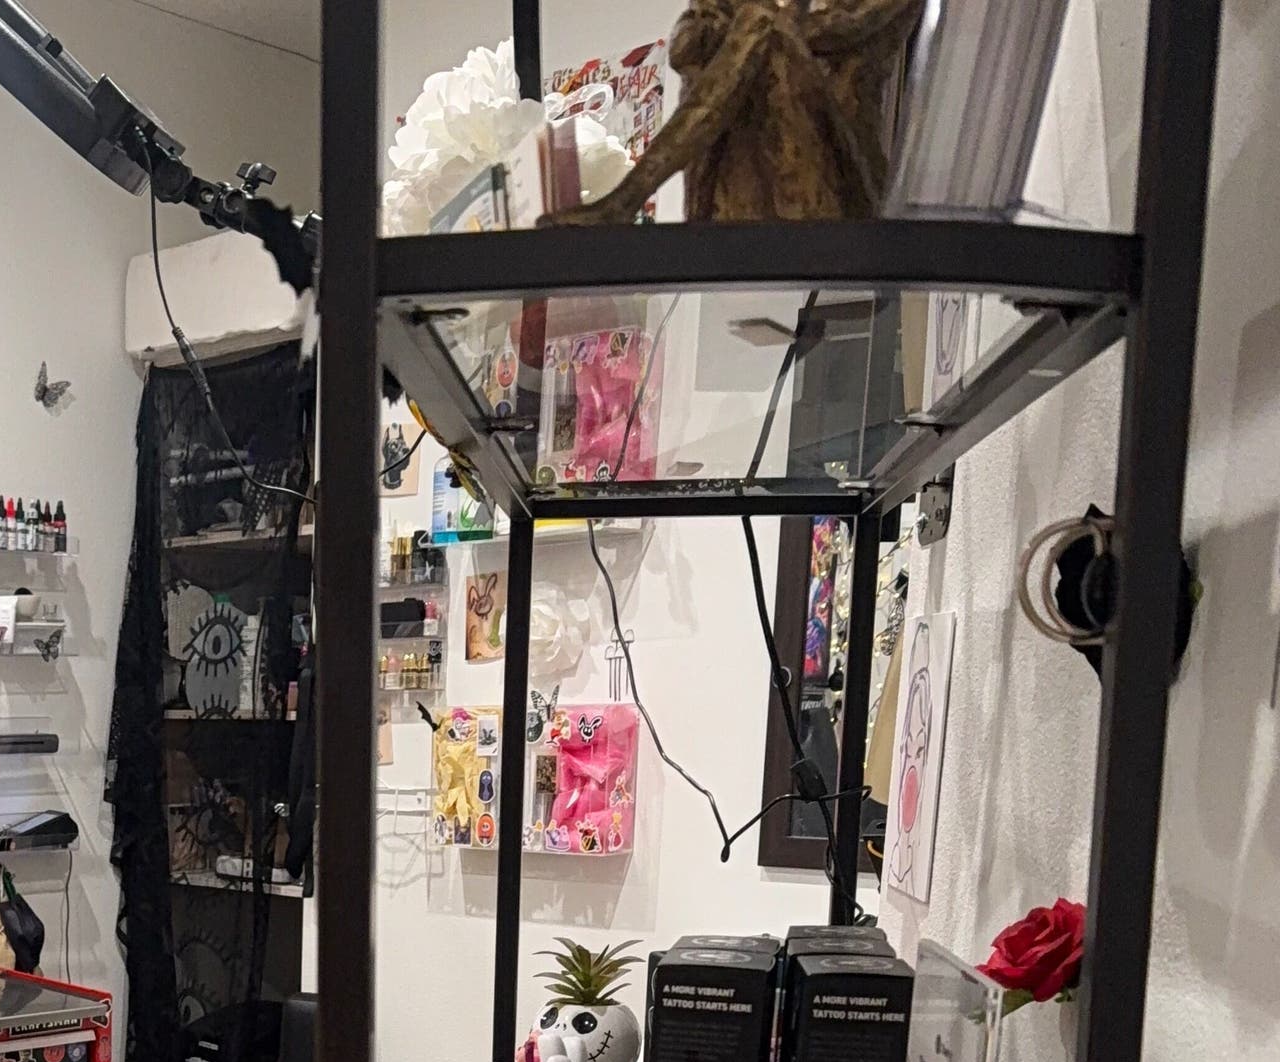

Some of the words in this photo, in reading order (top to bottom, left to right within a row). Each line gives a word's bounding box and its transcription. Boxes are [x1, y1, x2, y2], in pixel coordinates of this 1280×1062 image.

[663, 985, 670, 993] A
[671, 985, 696, 995] MORE
[697, 987, 736, 997] VIBRANT
[662, 998, 694, 1009] TATTOO
[696, 1001, 728, 1012] STARTS
[729, 1003, 753, 1013] HERE
[813, 995, 820, 1003] A
[822, 995, 847, 1005] MORE
[849, 996, 888, 1007] VIBRANT
[812, 1009, 846, 1019] TATTOO
[847, 1011, 881, 1021] STARTS
[882, 1013, 906, 1022] HERE
